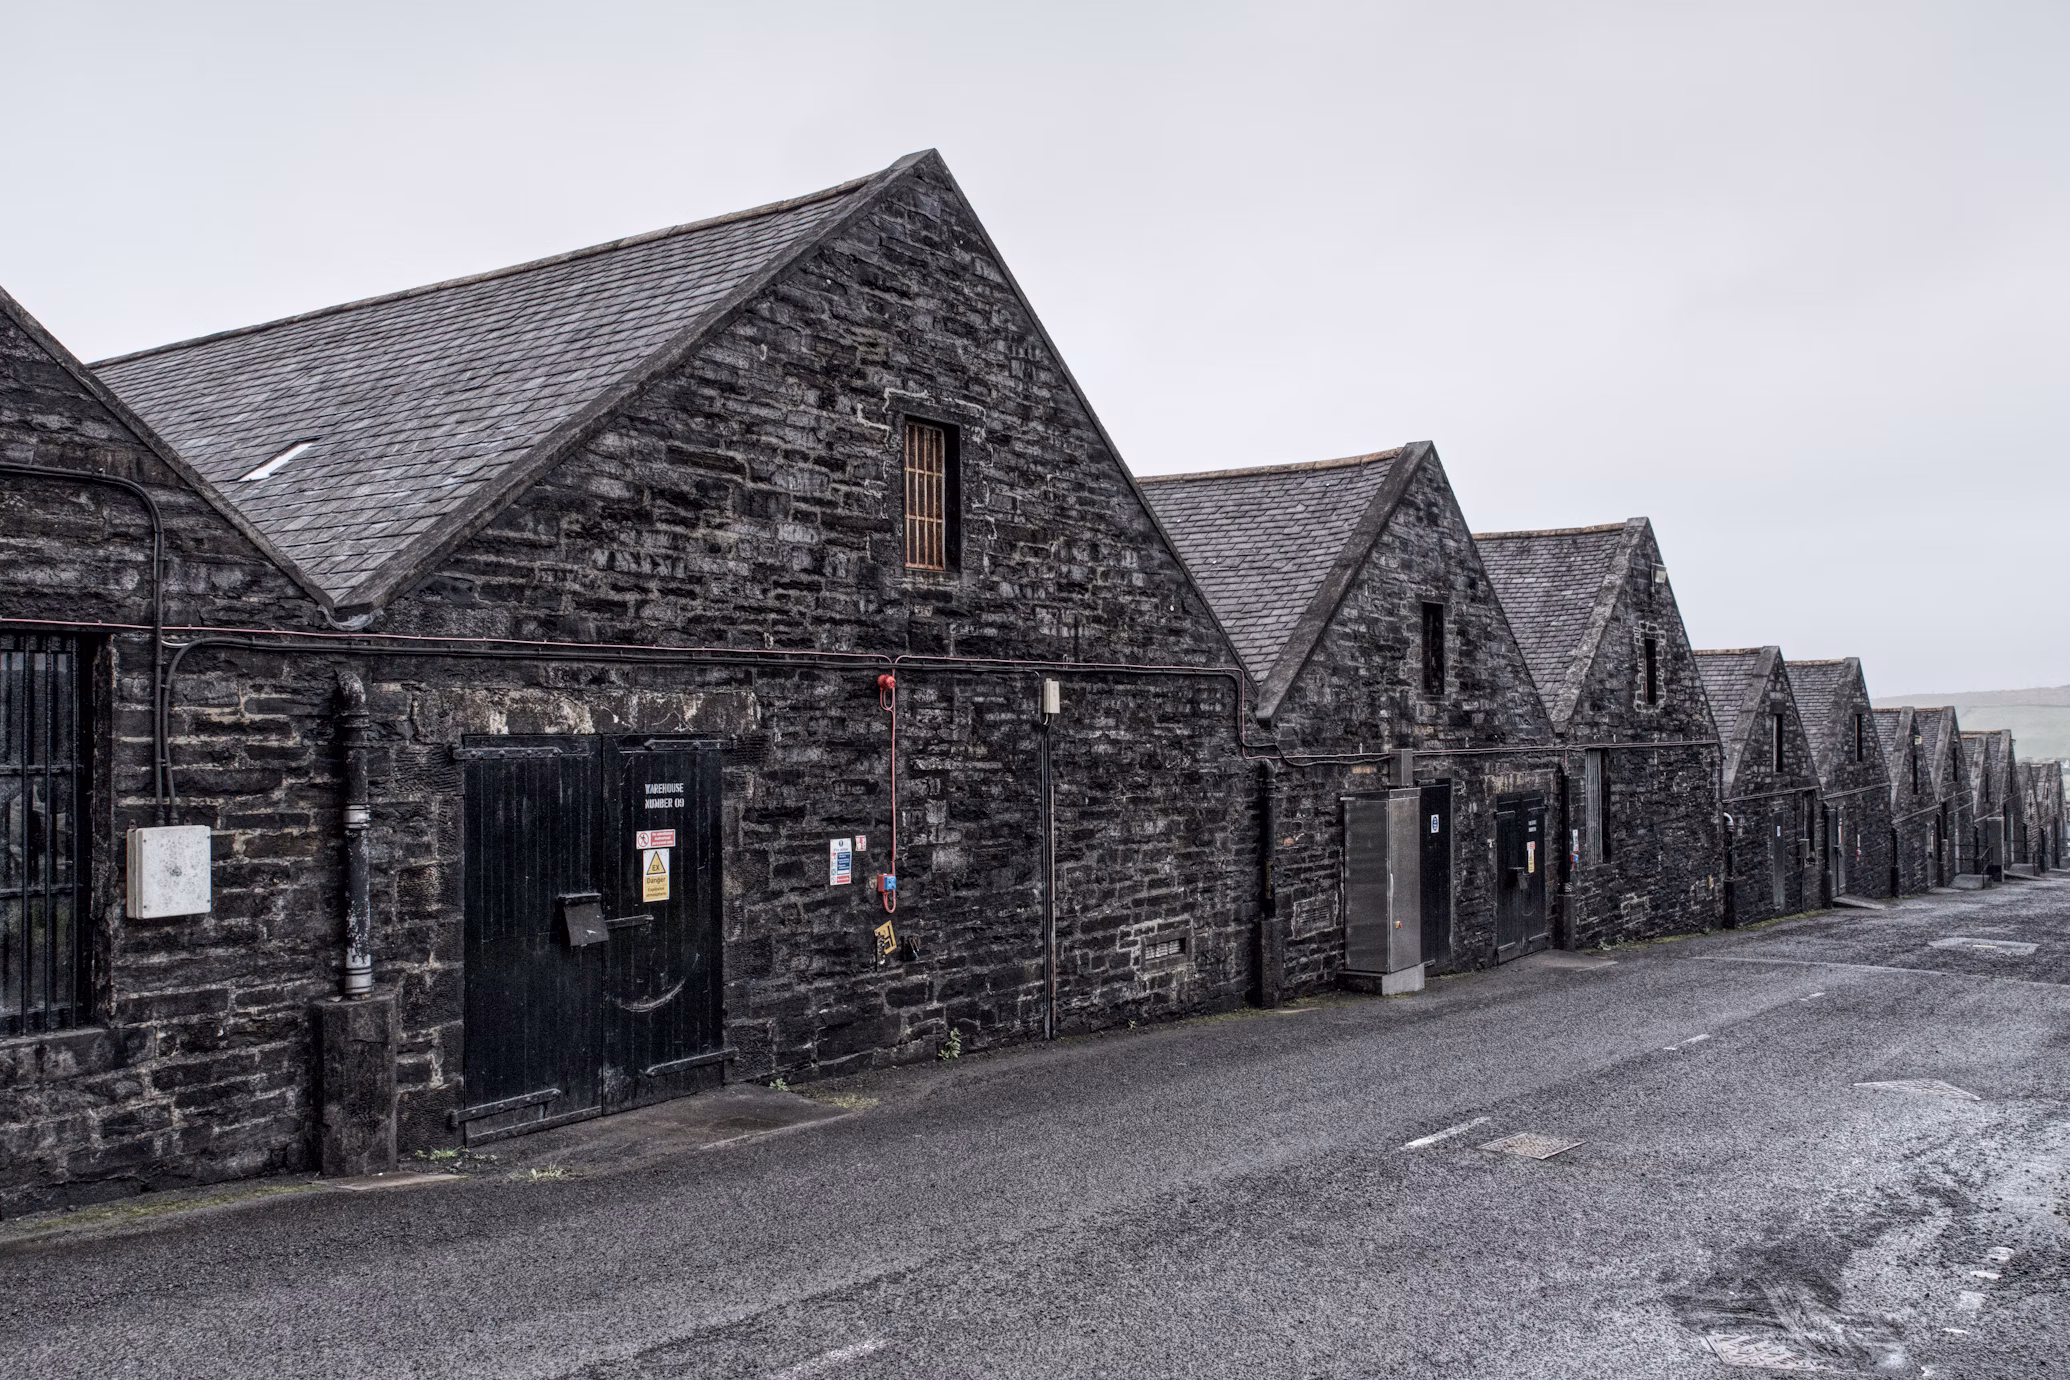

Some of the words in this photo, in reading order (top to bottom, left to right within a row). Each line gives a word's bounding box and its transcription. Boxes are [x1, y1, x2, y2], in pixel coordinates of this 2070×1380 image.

[644, 783, 684, 794] WAREHOUSE
[644, 798, 672, 809] NUMBER
[674, 798, 684, 808] 09
